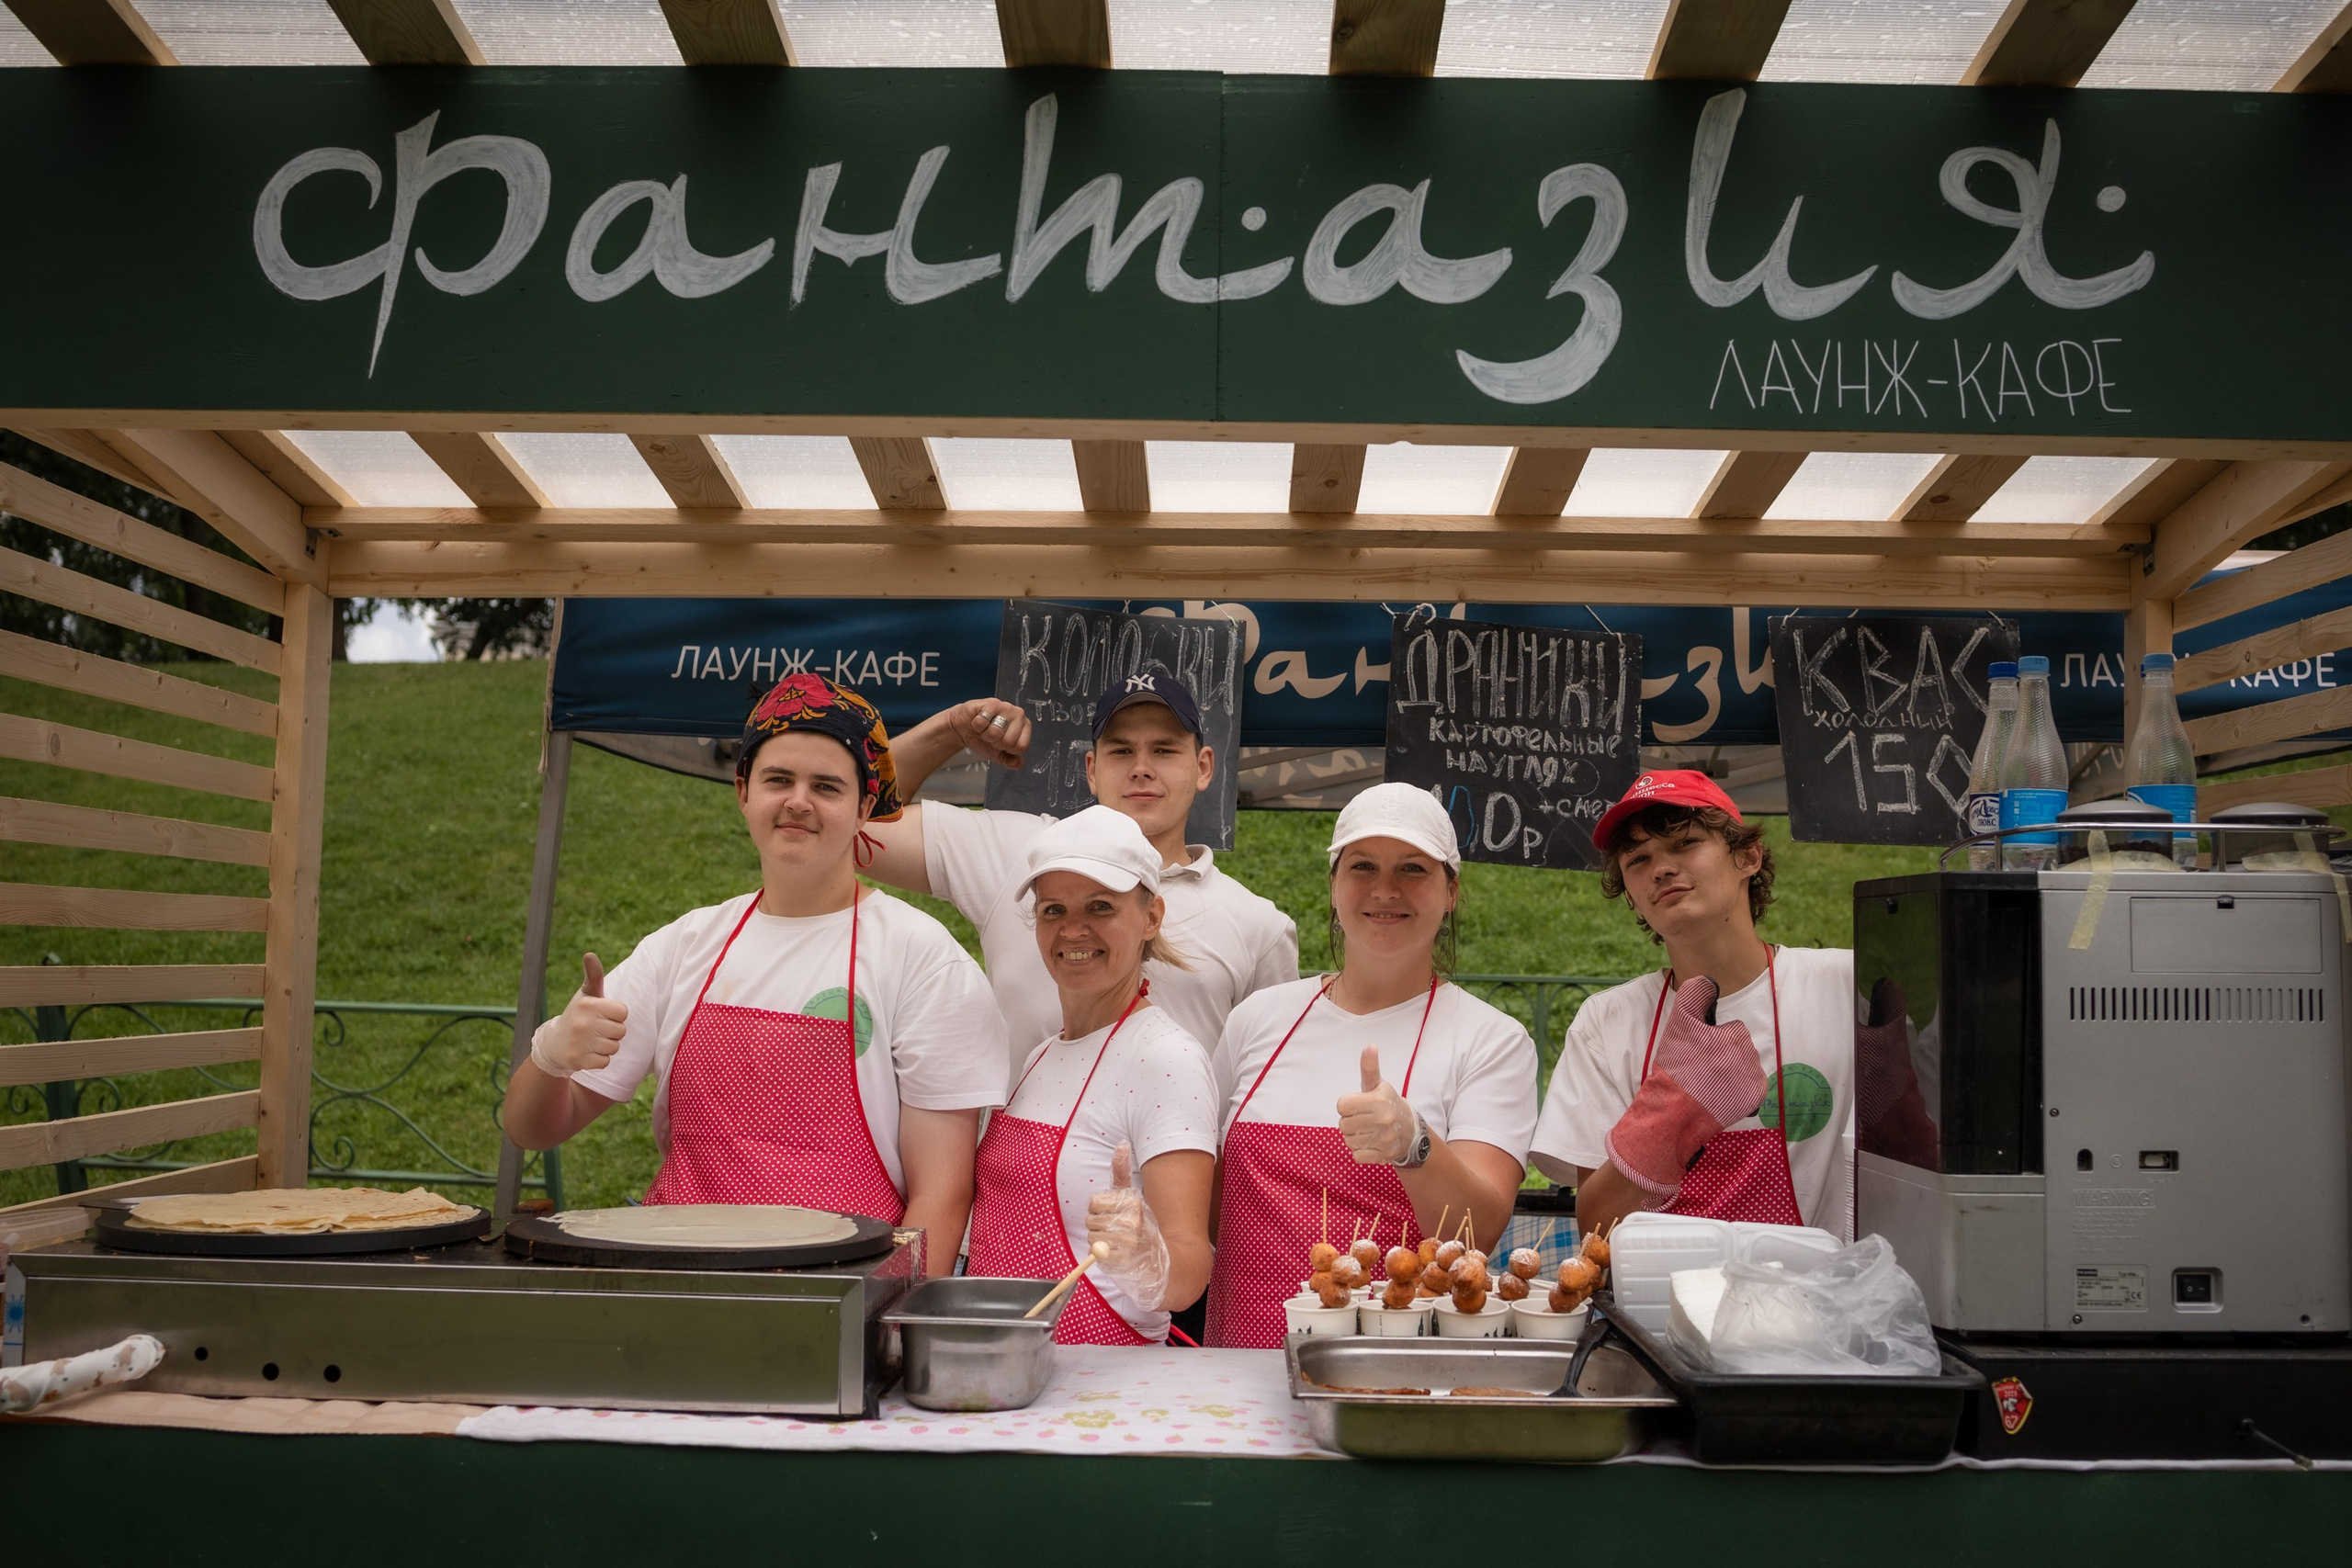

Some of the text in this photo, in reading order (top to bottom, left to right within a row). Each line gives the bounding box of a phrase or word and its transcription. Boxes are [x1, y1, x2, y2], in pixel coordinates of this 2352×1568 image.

[1709, 337, 2132, 422] ЛАУНЖ-КАФЕ
[671, 645, 941, 687] ЛАУНЖ-КАФЕ
[1125, 672, 1156, 694] NY
[1793, 625, 1991, 717] КВАС
[1824, 730, 1973, 816] 150
